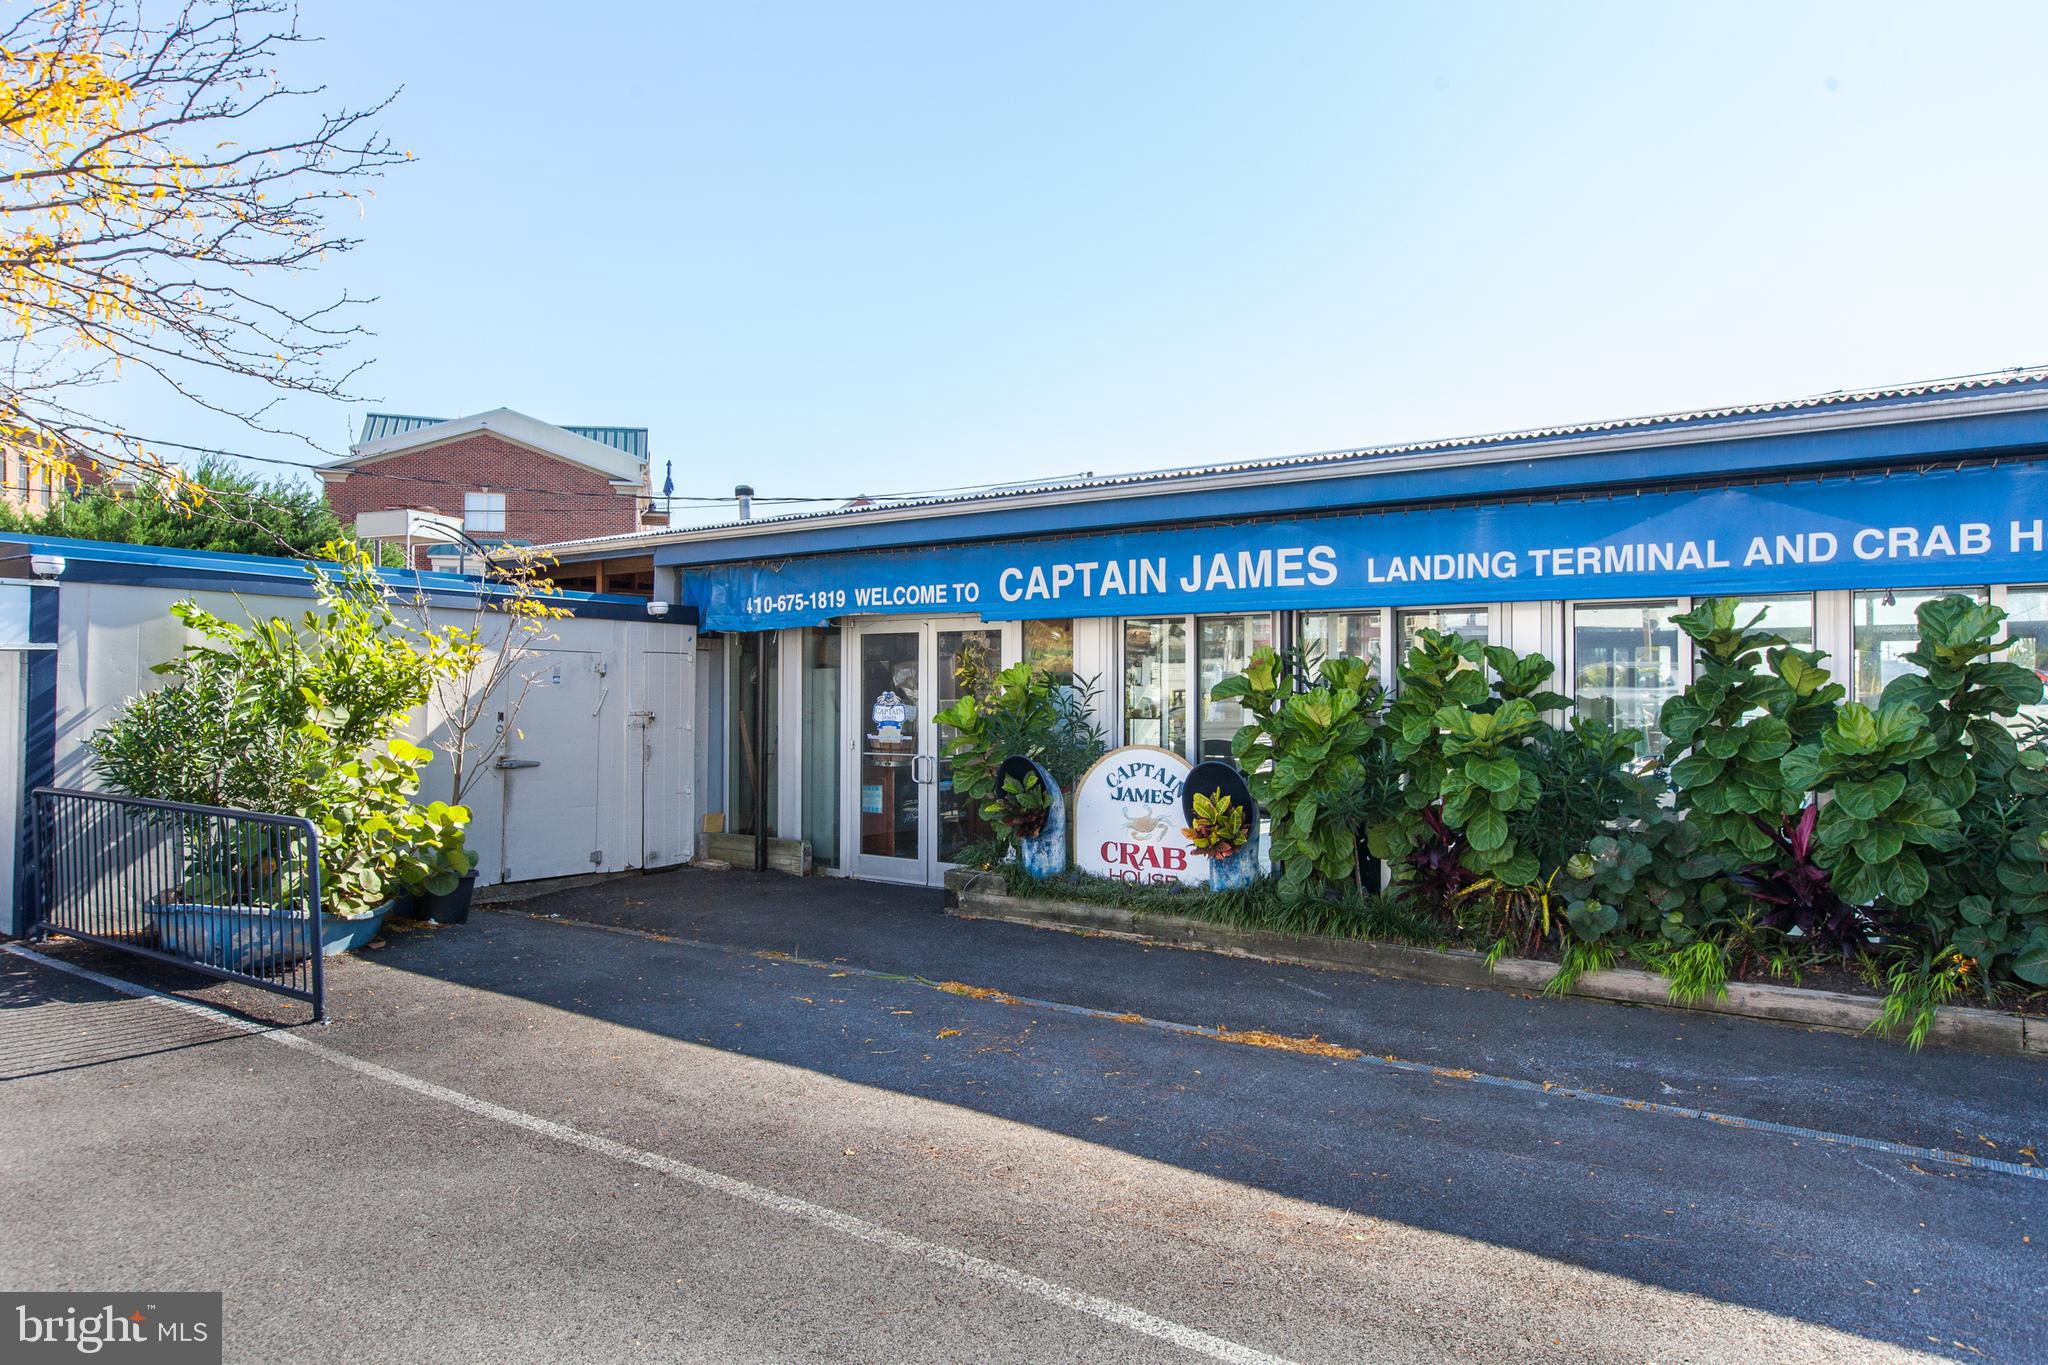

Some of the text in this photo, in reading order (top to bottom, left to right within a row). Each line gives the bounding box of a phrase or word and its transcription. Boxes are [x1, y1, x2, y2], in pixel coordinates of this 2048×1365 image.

[746, 519, 2048, 614] 410-675-1819 WELCOME TO CAPTAIN JAMES LANDING TERMINAL AND CRAB H
[1111, 786, 1174, 805] JAMES
[1101, 841, 1188, 871] CRAB
